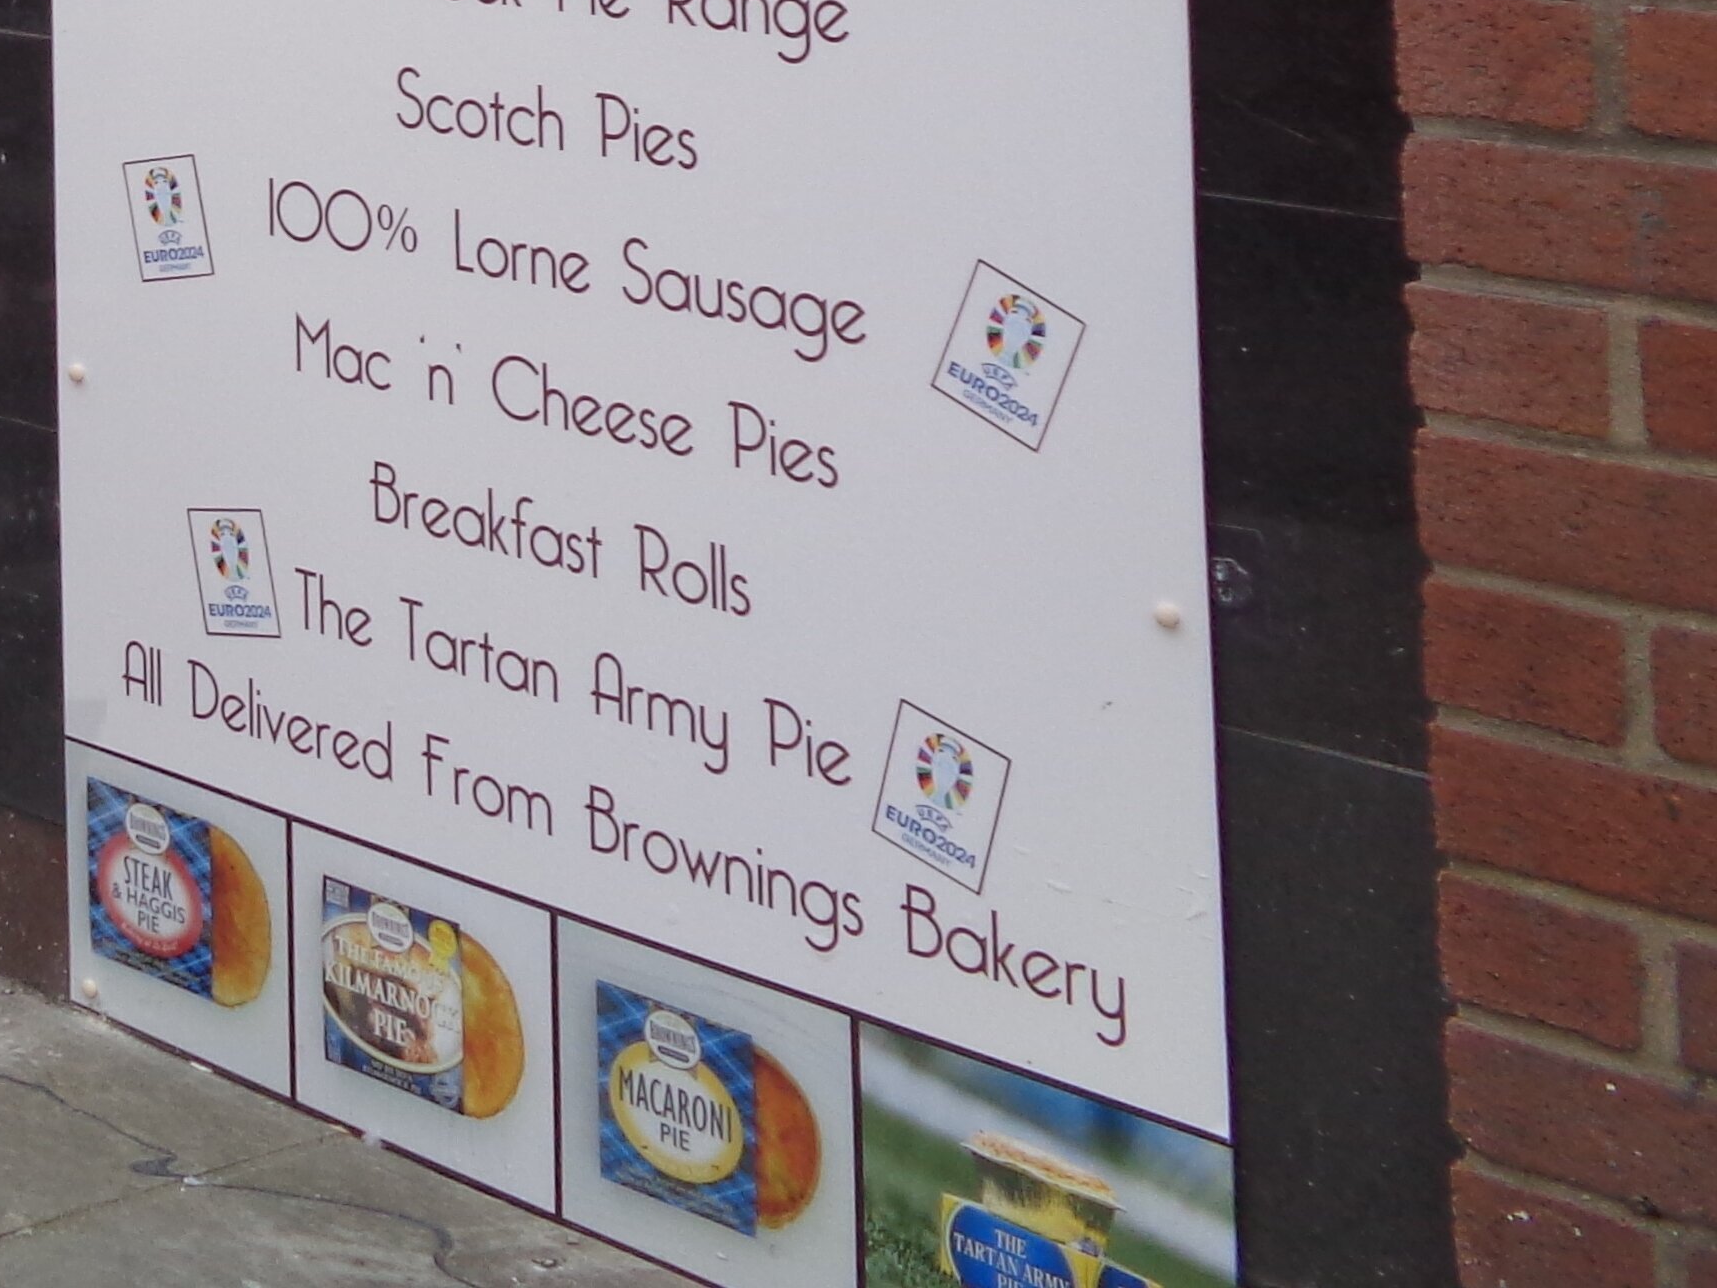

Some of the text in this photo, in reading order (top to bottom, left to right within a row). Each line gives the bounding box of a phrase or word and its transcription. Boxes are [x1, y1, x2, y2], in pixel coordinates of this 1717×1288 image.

[395, 67, 699, 172] Scotch Pies
[143, 245, 204, 264] EURO2024
[267, 176, 868, 360] 100% Lorne Sausage
[295, 312, 392, 396] Mac
[490, 353, 695, 458] Cheese
[730, 400, 841, 490] Pies
[947, 360, 1039, 427] EURO2024
[368, 461, 753, 618] Breakfast Rolls
[208, 603, 272, 618] EURO2024
[294, 567, 853, 789] The Tartan Army Pie
[123, 640, 1129, 1048] All Delivered From Brownings Bakery
[885, 805, 976, 869] EURO2024
[124, 855, 173, 901] STEAK
[126, 887, 185, 925] HAGGIS
[137, 910, 160, 933] PIE
[335, 935, 369, 963] THE
[373, 1007, 412, 1046] PIE
[619, 1066, 732, 1143] MACARONI
[659, 1123, 691, 1152] PIE
[953, 1232, 1016, 1276] TARTAN
[995, 1229, 1026, 1259] THE
